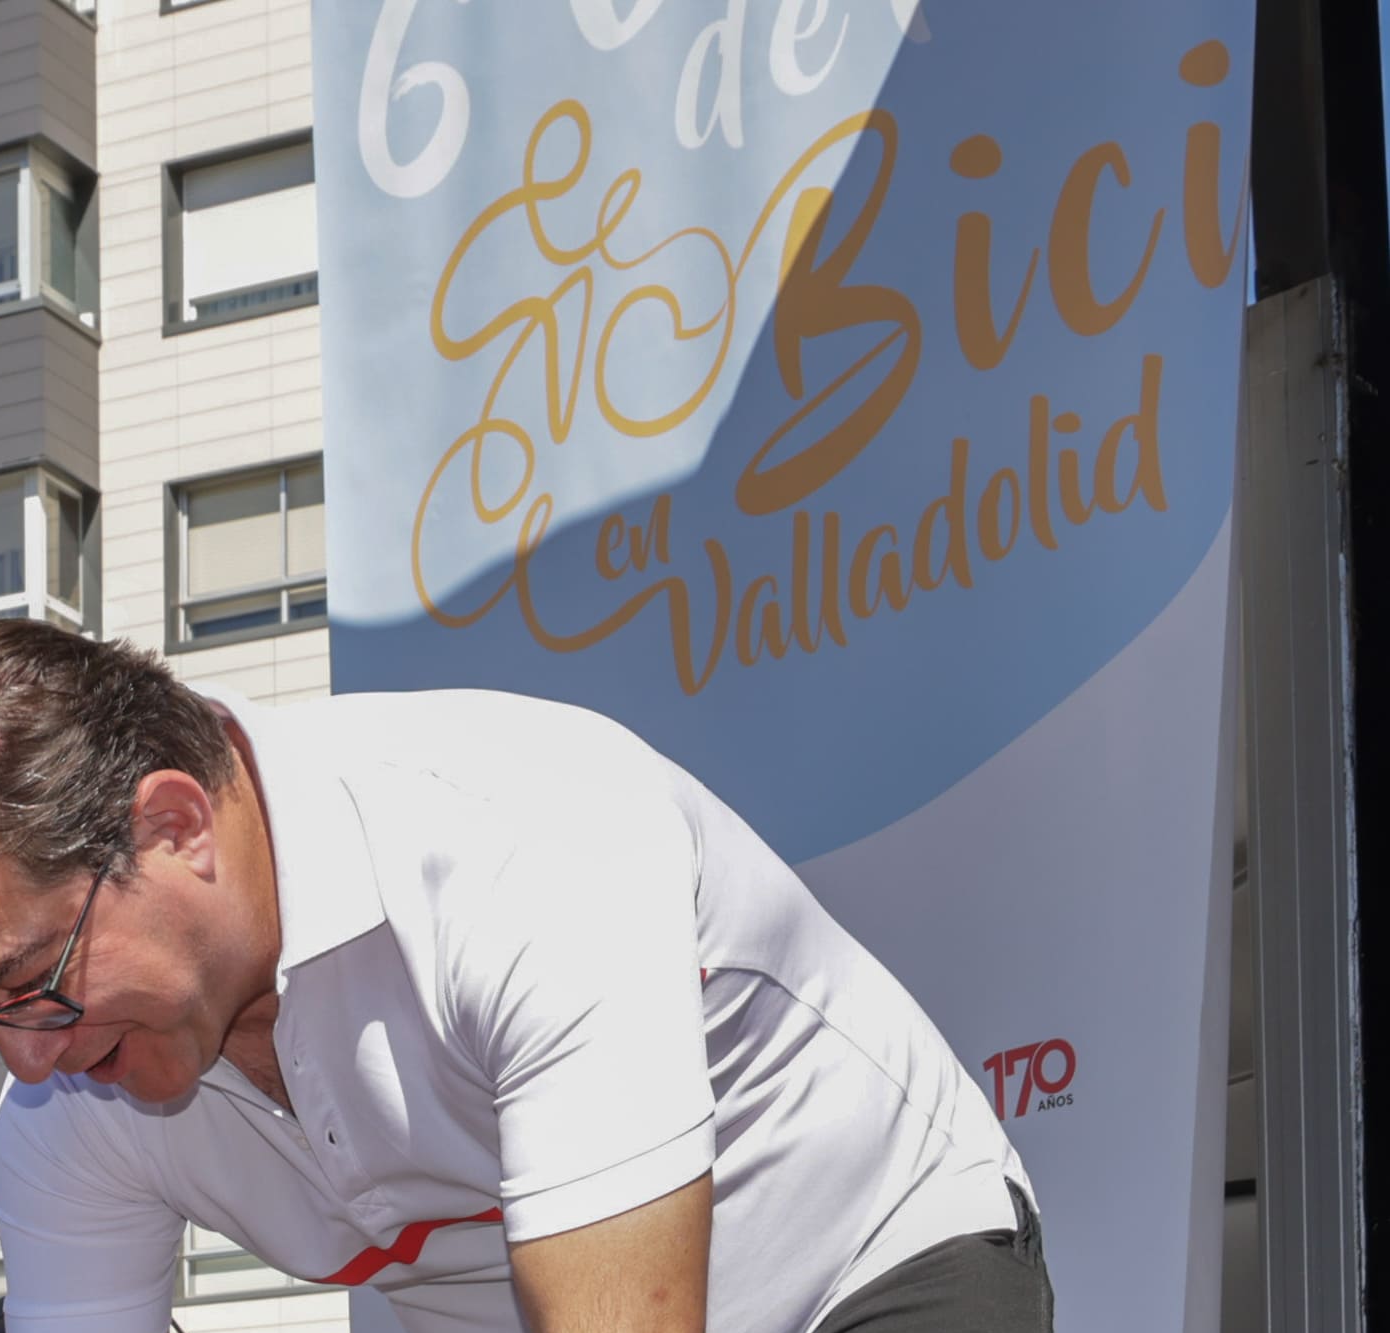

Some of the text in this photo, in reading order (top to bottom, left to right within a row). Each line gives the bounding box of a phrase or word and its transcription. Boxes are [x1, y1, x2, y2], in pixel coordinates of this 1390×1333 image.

[732, 38, 1251, 517] Bici
[595, 353, 1170, 696] en Valladolid
[982, 1038, 1076, 1121] 170
[1037, 1092, 1074, 1112] AÑOS
